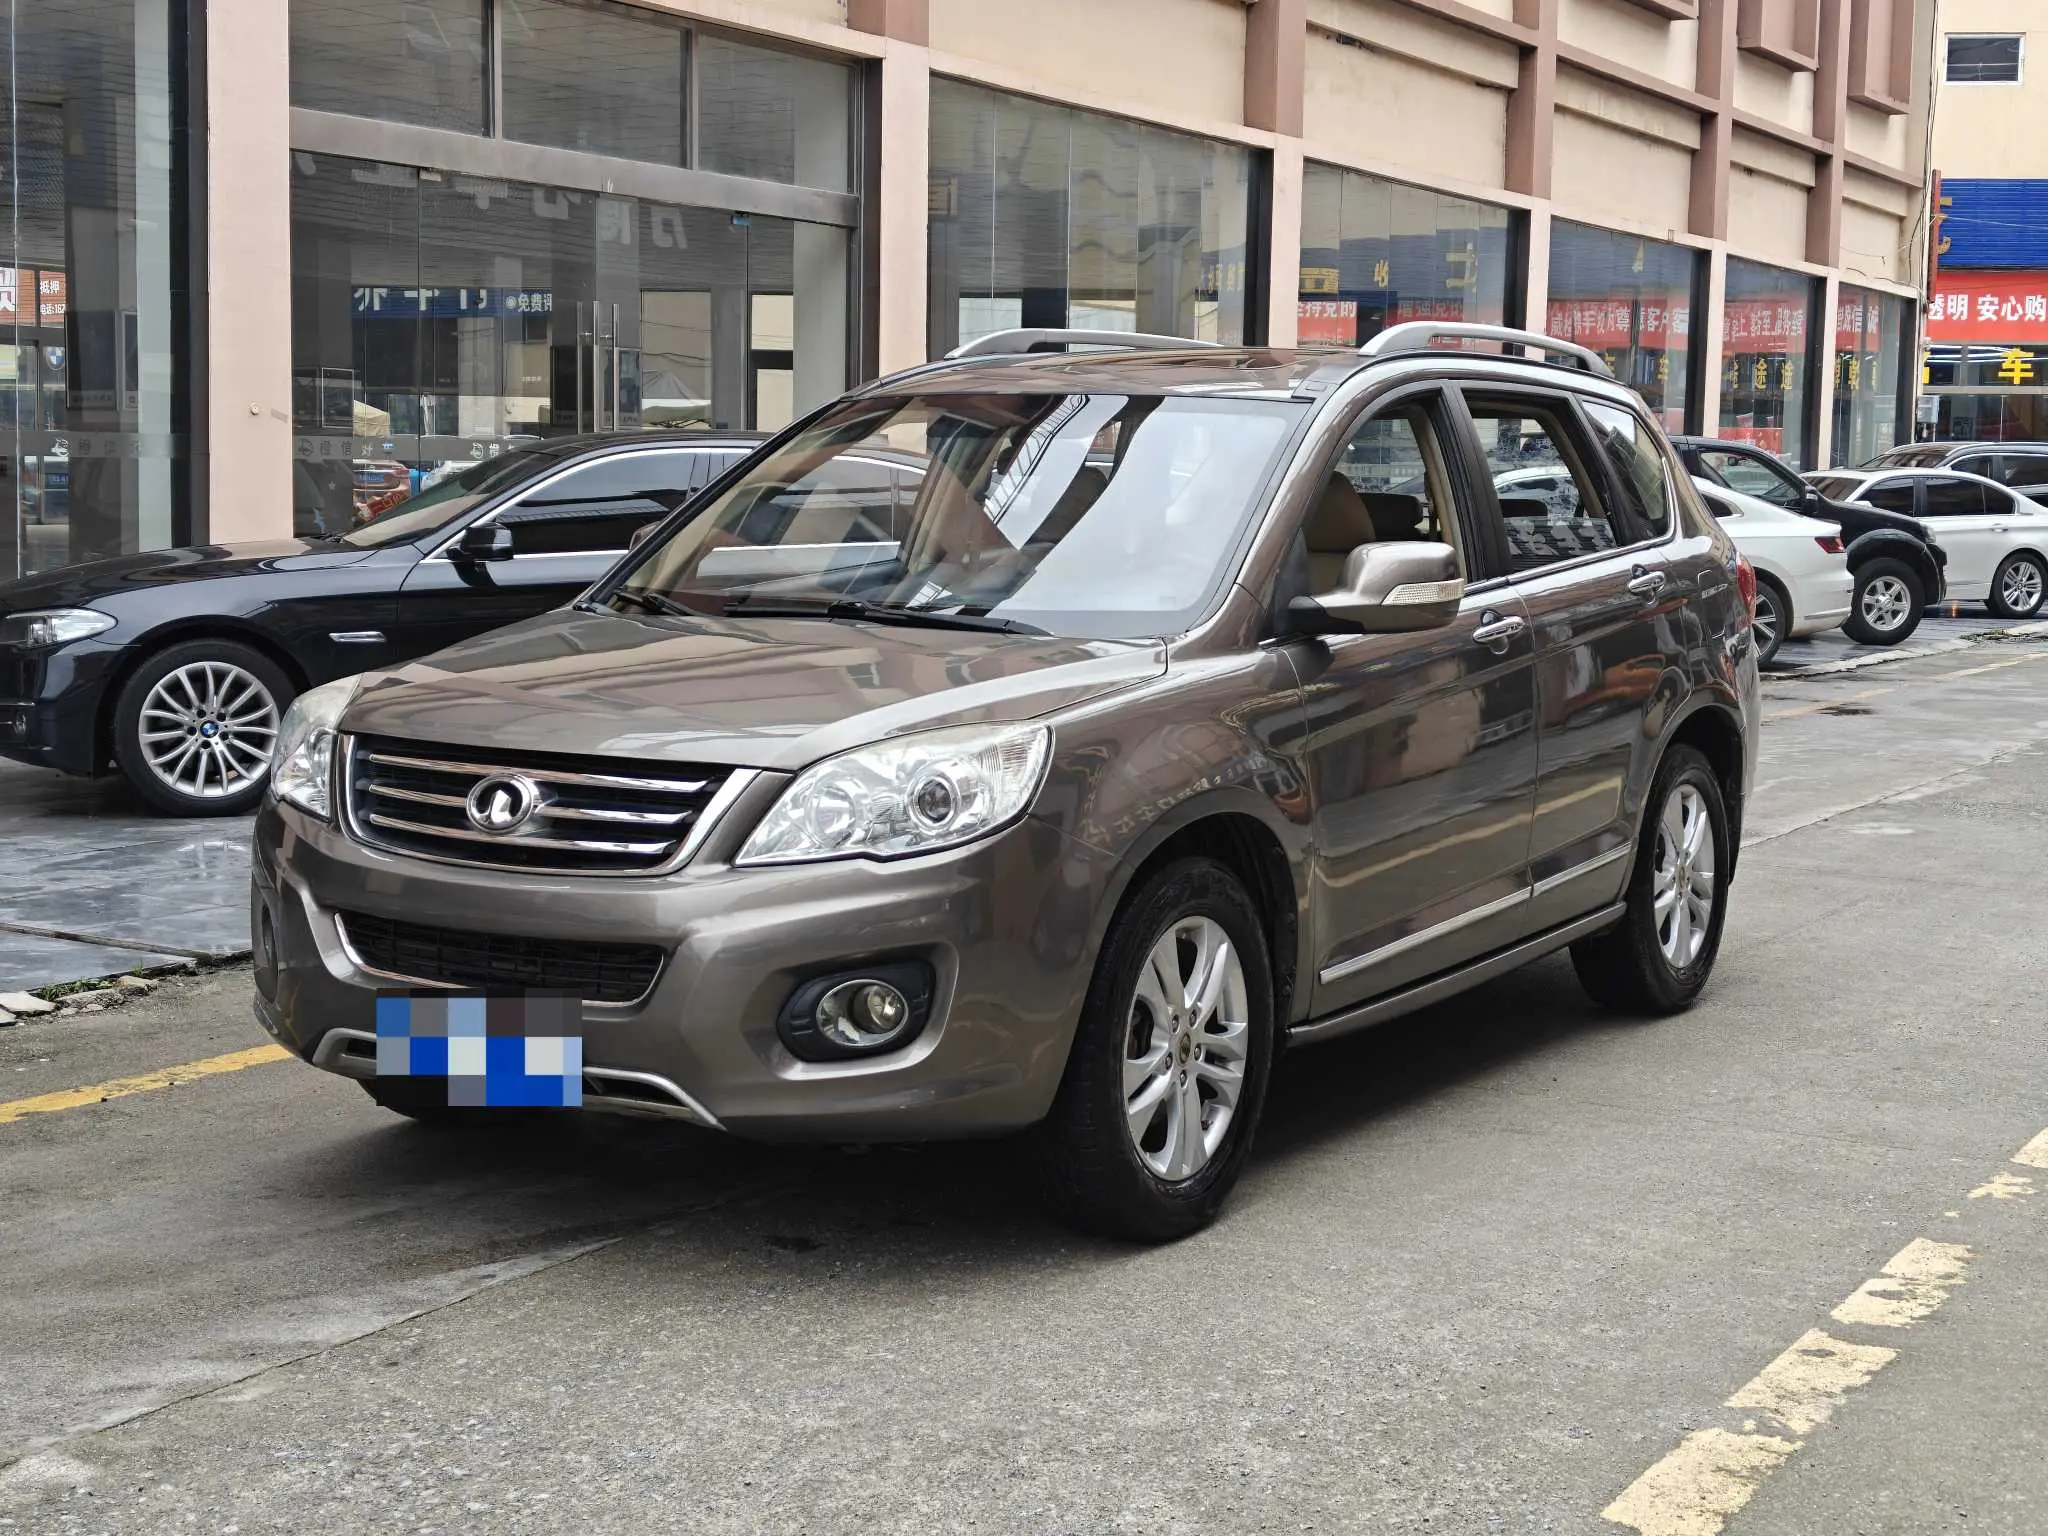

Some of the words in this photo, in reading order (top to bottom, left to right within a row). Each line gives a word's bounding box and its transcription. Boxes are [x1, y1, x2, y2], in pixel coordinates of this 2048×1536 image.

[1927, 293, 1968, 321] 透明
[1976, 294, 2047, 322] 安心购
[1998, 346, 2035, 385] 车
